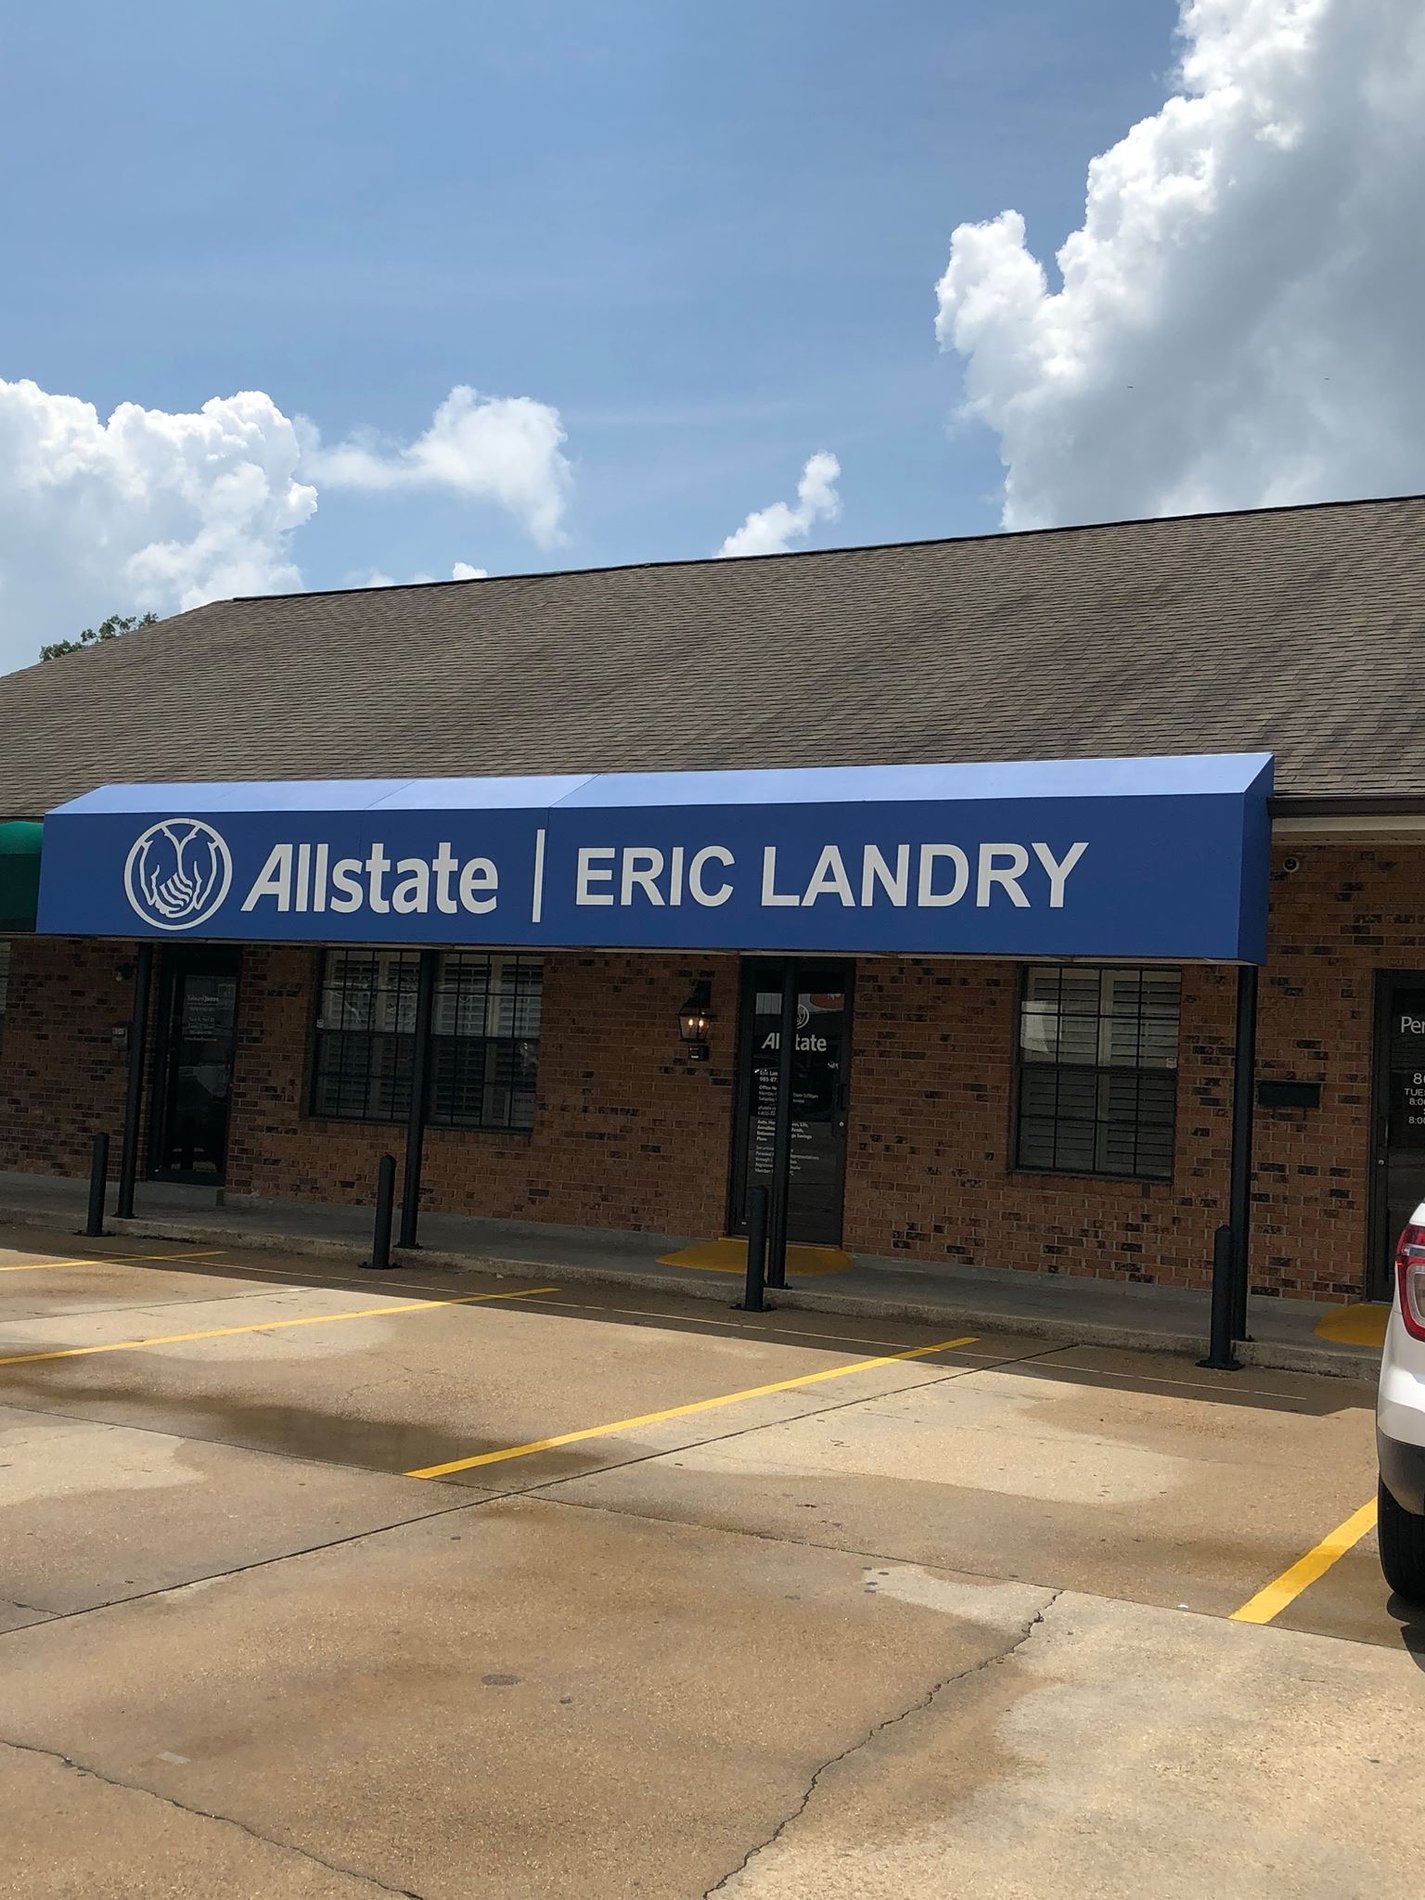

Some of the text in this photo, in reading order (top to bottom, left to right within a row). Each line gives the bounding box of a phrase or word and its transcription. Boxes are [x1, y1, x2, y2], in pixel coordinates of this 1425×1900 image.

[241, 842, 1089, 914] Allstate ERIC LANDRY
[761, 1032, 827, 1052] Altate
